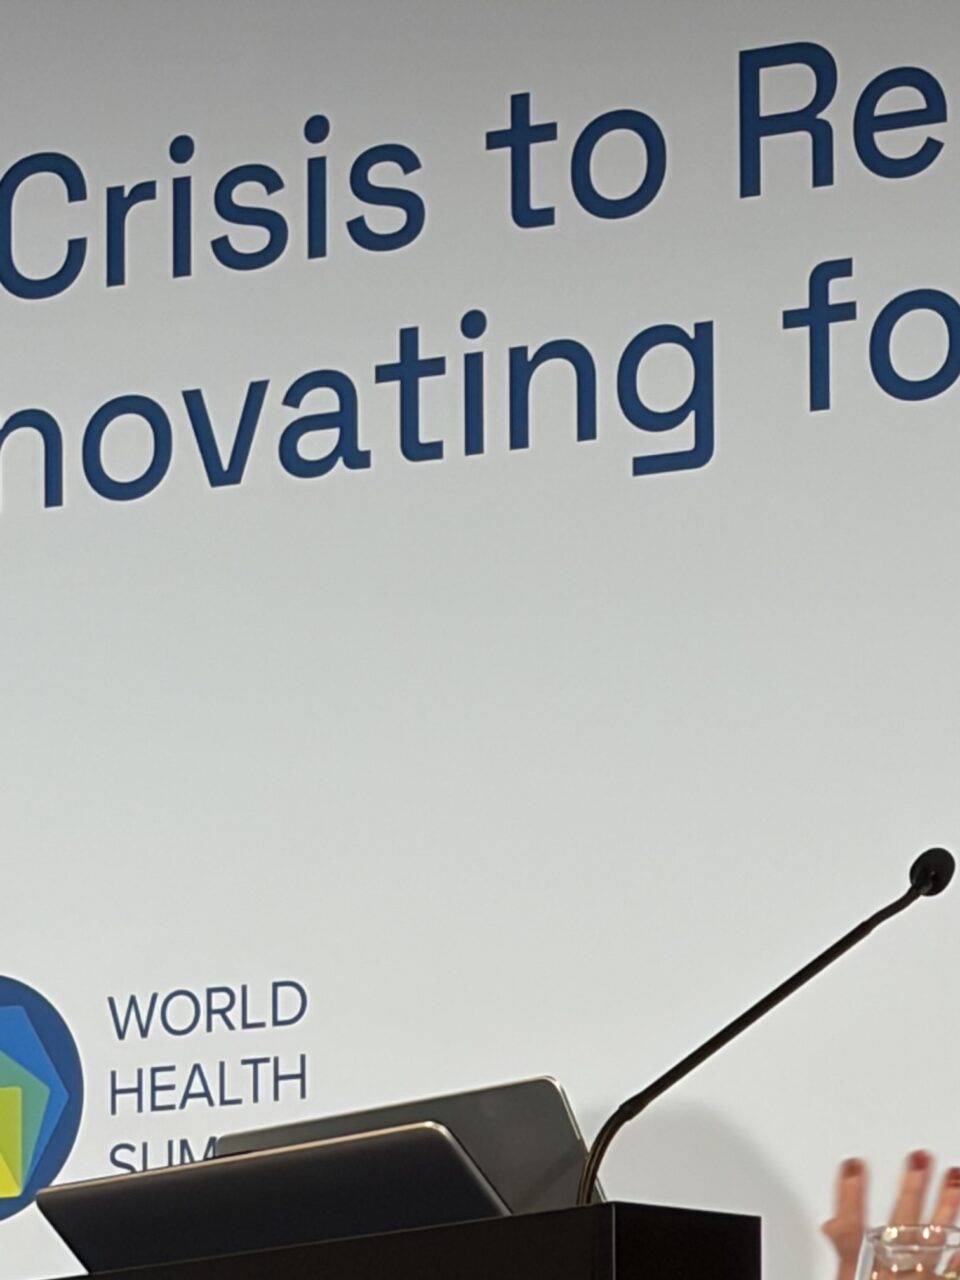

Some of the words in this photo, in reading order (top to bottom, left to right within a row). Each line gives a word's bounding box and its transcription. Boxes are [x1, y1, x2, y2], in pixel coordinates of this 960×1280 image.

[0, 114, 426, 300] Crisis
[485, 91, 667, 229] to
[0, 309, 715, 508] novating
[107, 980, 308, 1041] WORLD
[109, 1054, 307, 1115] HEALTH
